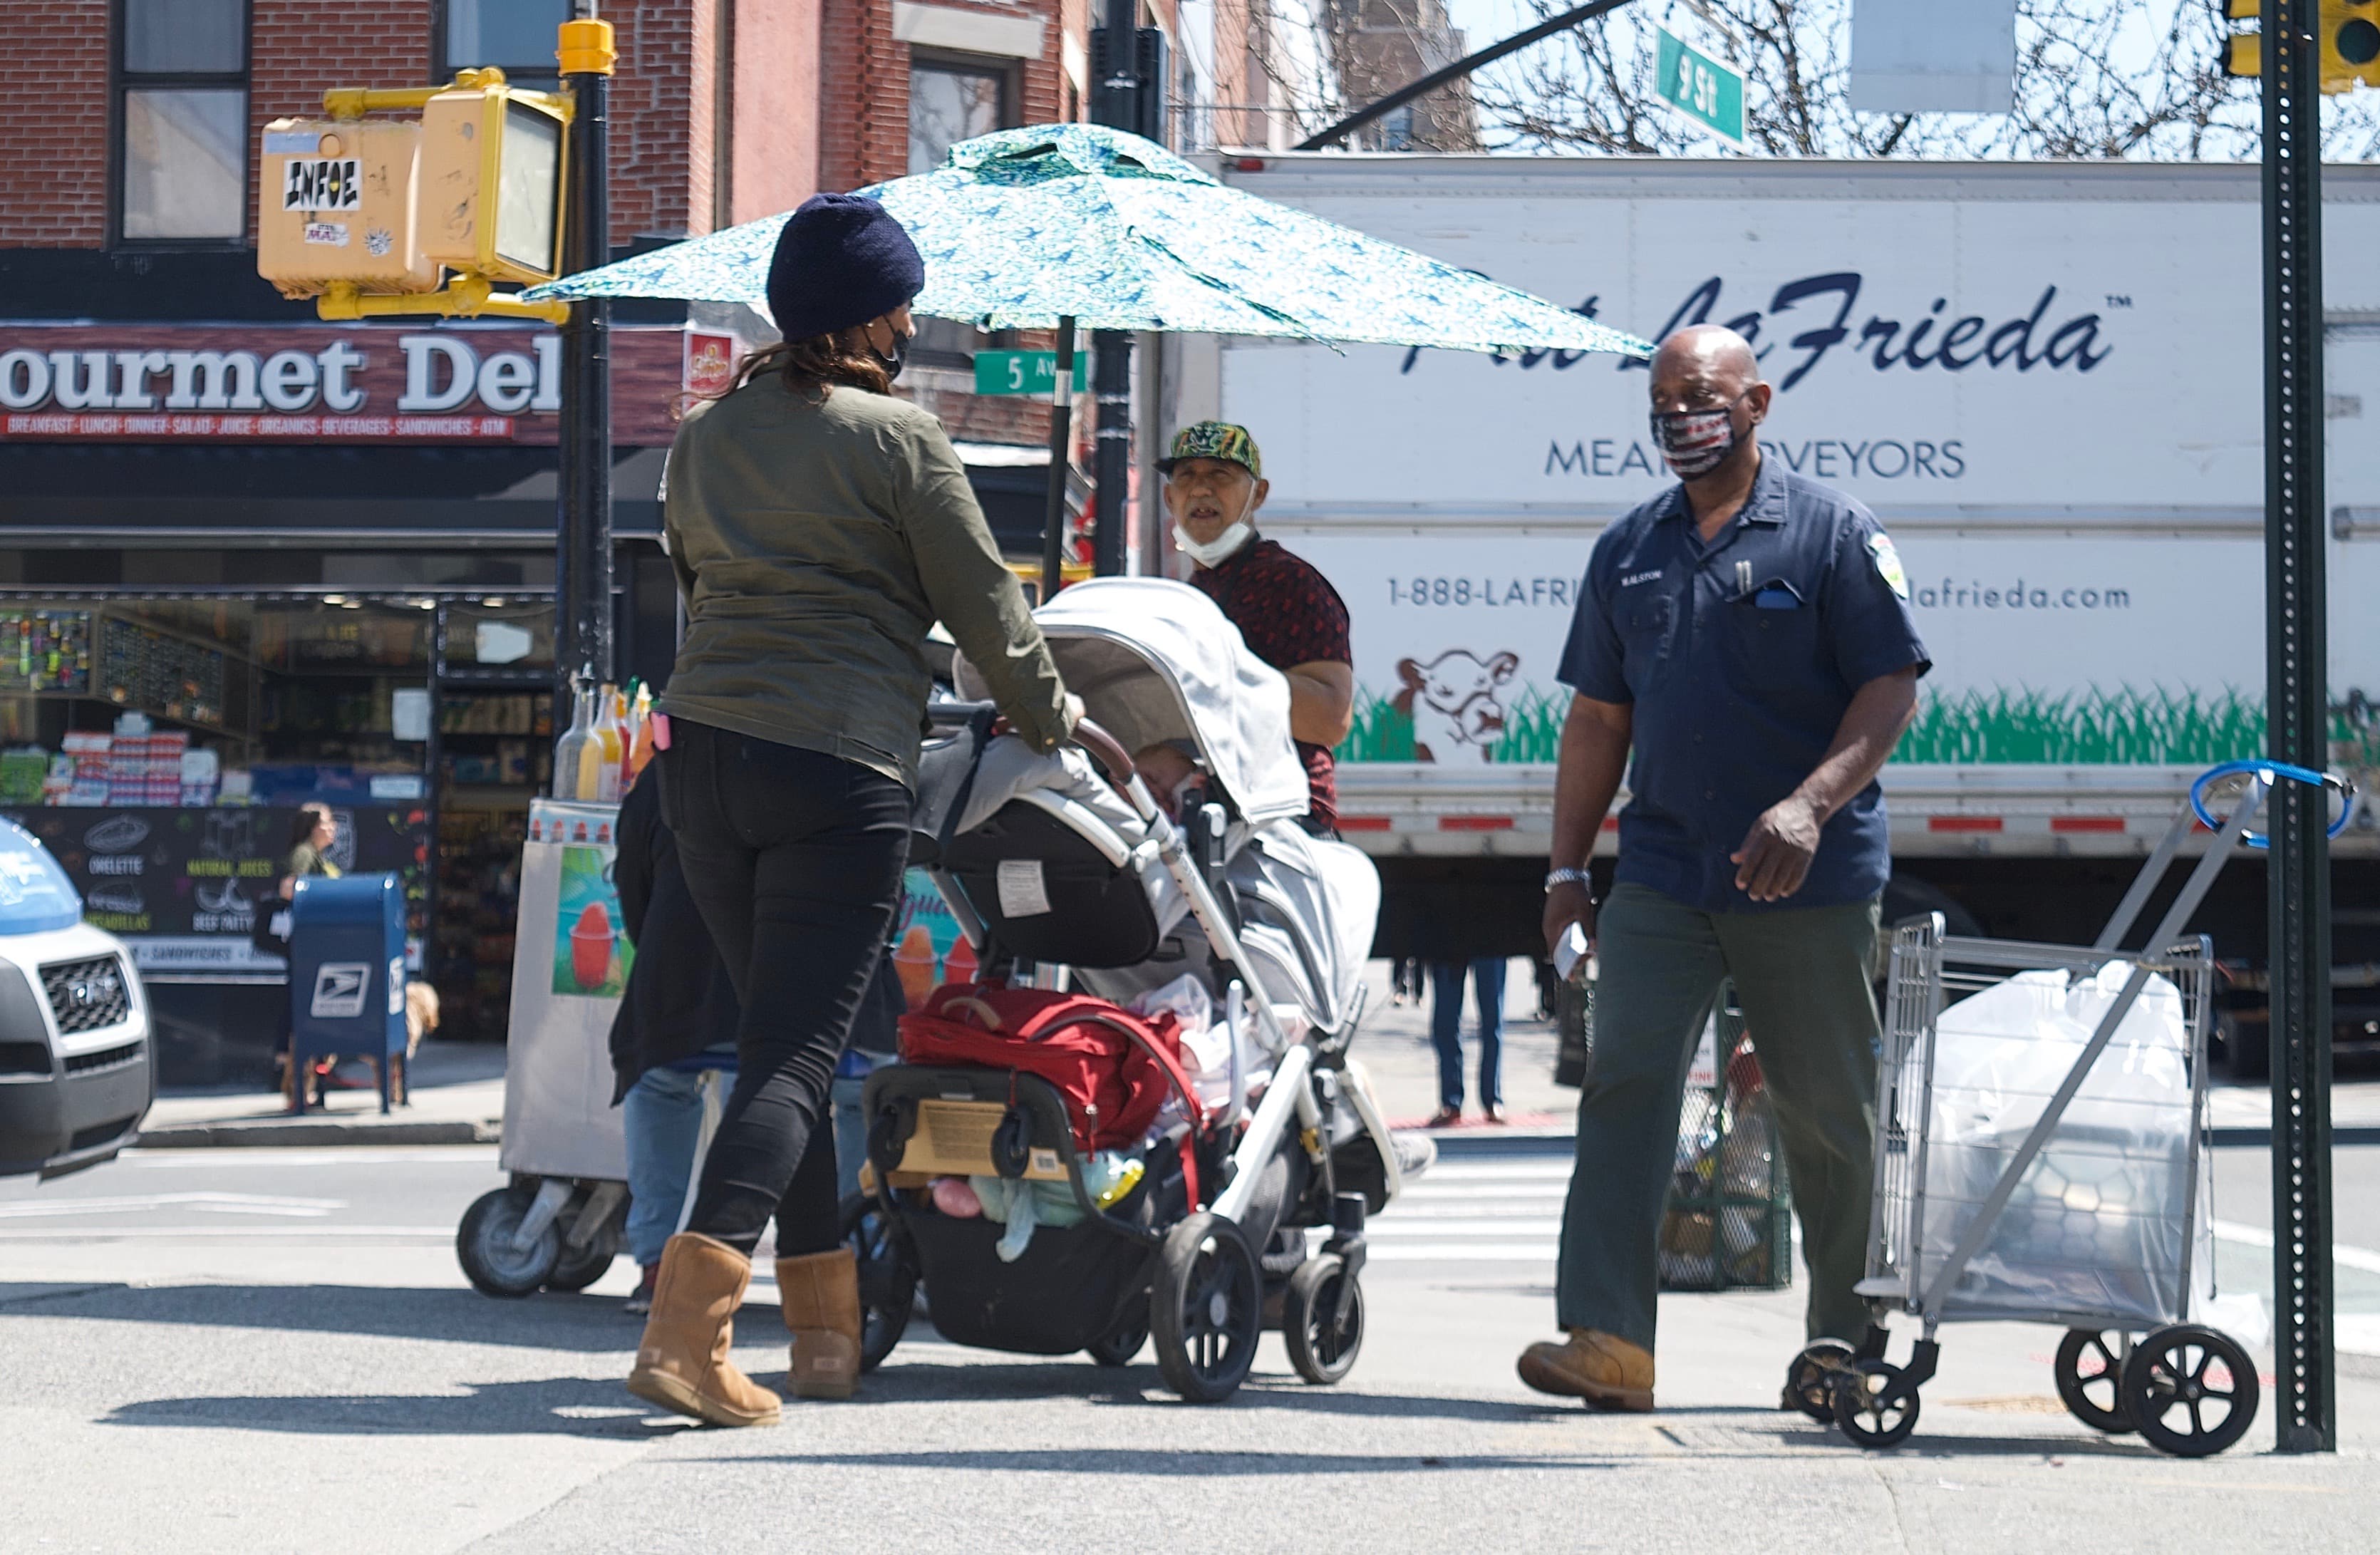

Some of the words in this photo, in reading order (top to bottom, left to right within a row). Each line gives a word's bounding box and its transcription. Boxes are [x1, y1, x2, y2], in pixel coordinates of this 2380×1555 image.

[1679, 55, 1692, 100] 9
[1694, 65, 1717, 118] St
[0, 340, 363, 413] ourmet
[397, 336, 562, 413] Del
[1008, 358, 1024, 390] 5
[7, 417, 72, 433] BREAKFAST
[80, 417, 117, 434] LUNCH
[124, 417, 166, 434] DINNER
[172, 417, 211, 434] SALAD
[217, 417, 250, 434] JUICE
[322, 417, 386, 434] BEVERAGES
[395, 418, 470, 435] SANDWICHES
[1757, 439, 1965, 478] VEYORS
[1388, 578, 1580, 606] 1-888-LAFRI
[1908, 577, 2131, 607] lafrieda.com
